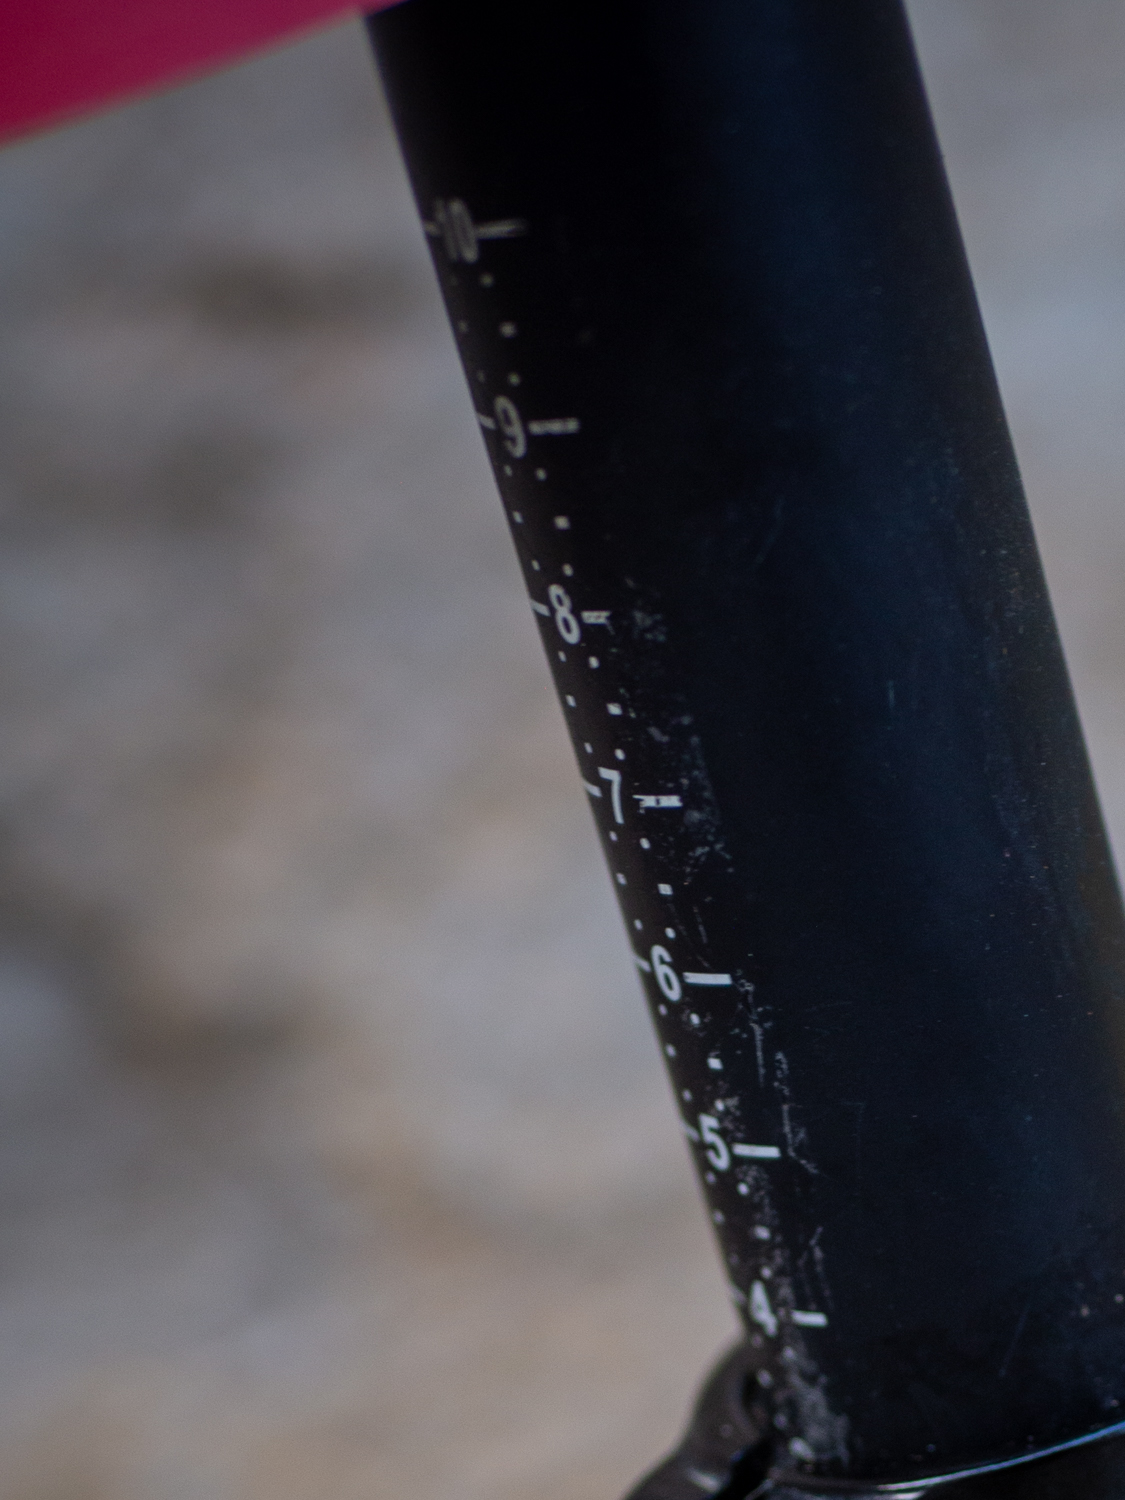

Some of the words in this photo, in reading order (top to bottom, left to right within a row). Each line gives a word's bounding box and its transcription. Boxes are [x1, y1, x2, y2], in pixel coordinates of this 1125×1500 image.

[434, 198, 478, 262] 10
[494, 395, 526, 459] 9
[548, 583, 580, 645] 8
[598, 766, 624, 824] 7
[651, 944, 681, 1003] 6
[699, 1112, 730, 1171] 5
[751, 1279, 778, 1337] 4
